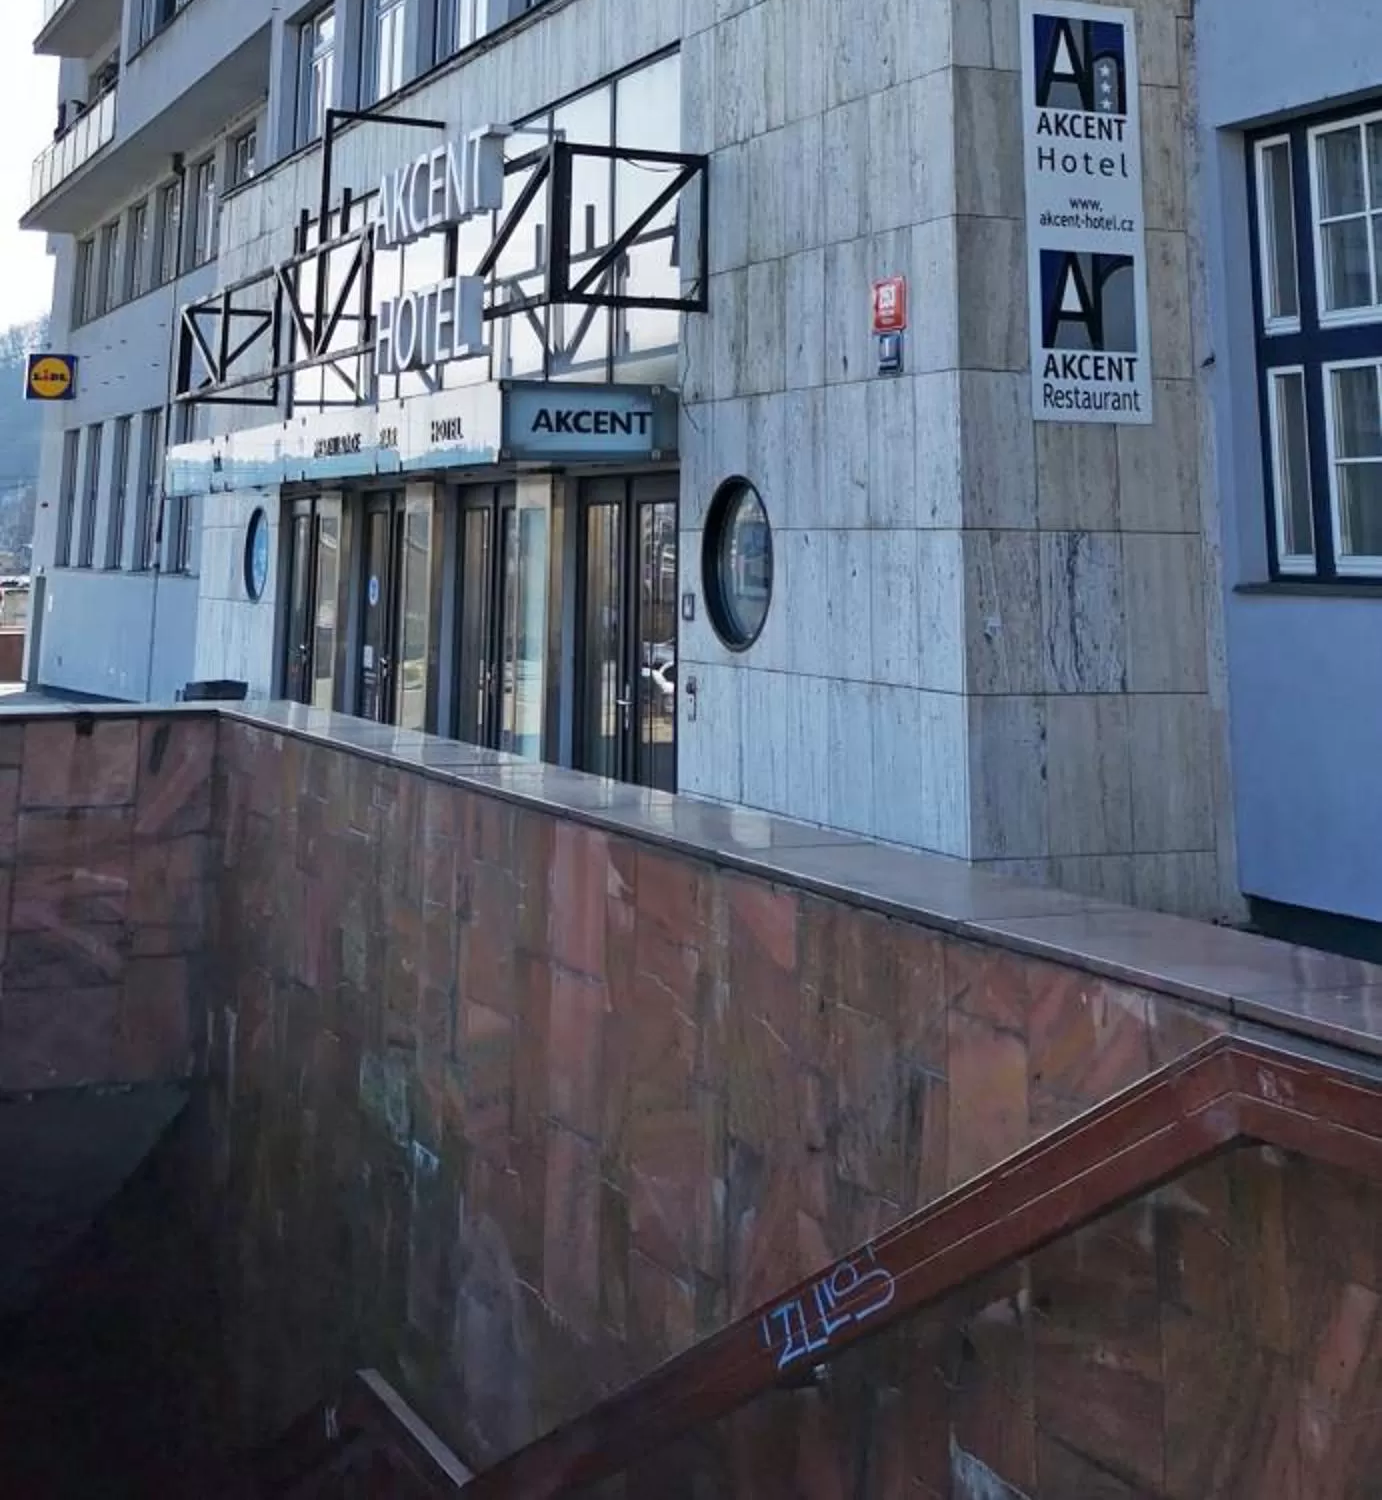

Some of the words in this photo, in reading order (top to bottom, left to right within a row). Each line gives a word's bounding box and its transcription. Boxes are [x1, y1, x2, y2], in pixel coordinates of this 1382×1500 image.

[1036, 111, 1127, 142] AKCENT
[1037, 145, 1128, 178] Hotel
[372, 123, 505, 248] AKCENT
[1069, 198, 1103, 212] www.
[1040, 211, 1135, 232] akcent-hotel.cz
[375, 276, 482, 375] HOTEL
[1043, 353, 1138, 382] AKCENT
[1043, 383, 1142, 412] Restaurant
[531, 408, 653, 435] AKCENT
